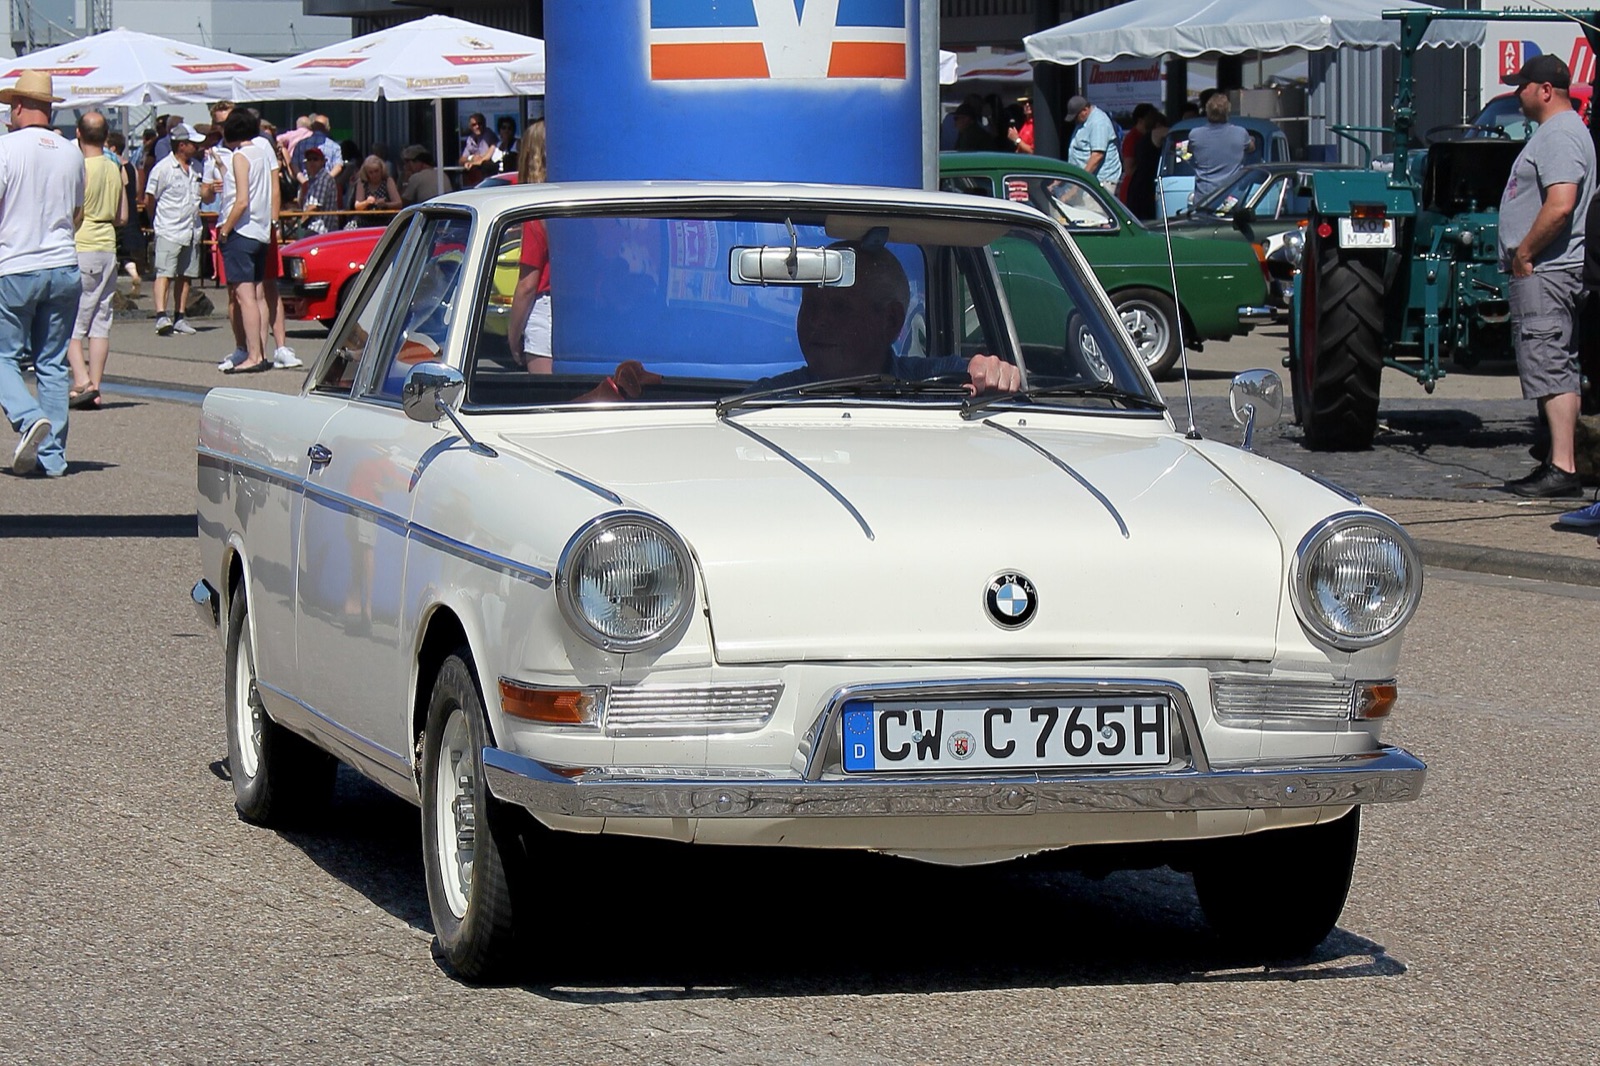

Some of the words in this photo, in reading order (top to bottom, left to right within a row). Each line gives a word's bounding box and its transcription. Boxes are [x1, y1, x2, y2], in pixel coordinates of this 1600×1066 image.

[1347, 234, 1358, 245] M
[1366, 234, 1391, 244] 234
[990, 575, 1034, 594] BMW
[879, 709, 944, 761] CW
[984, 707, 1016, 759] C
[1030, 704, 1165, 758] 765H
[854, 743, 866, 759] D
